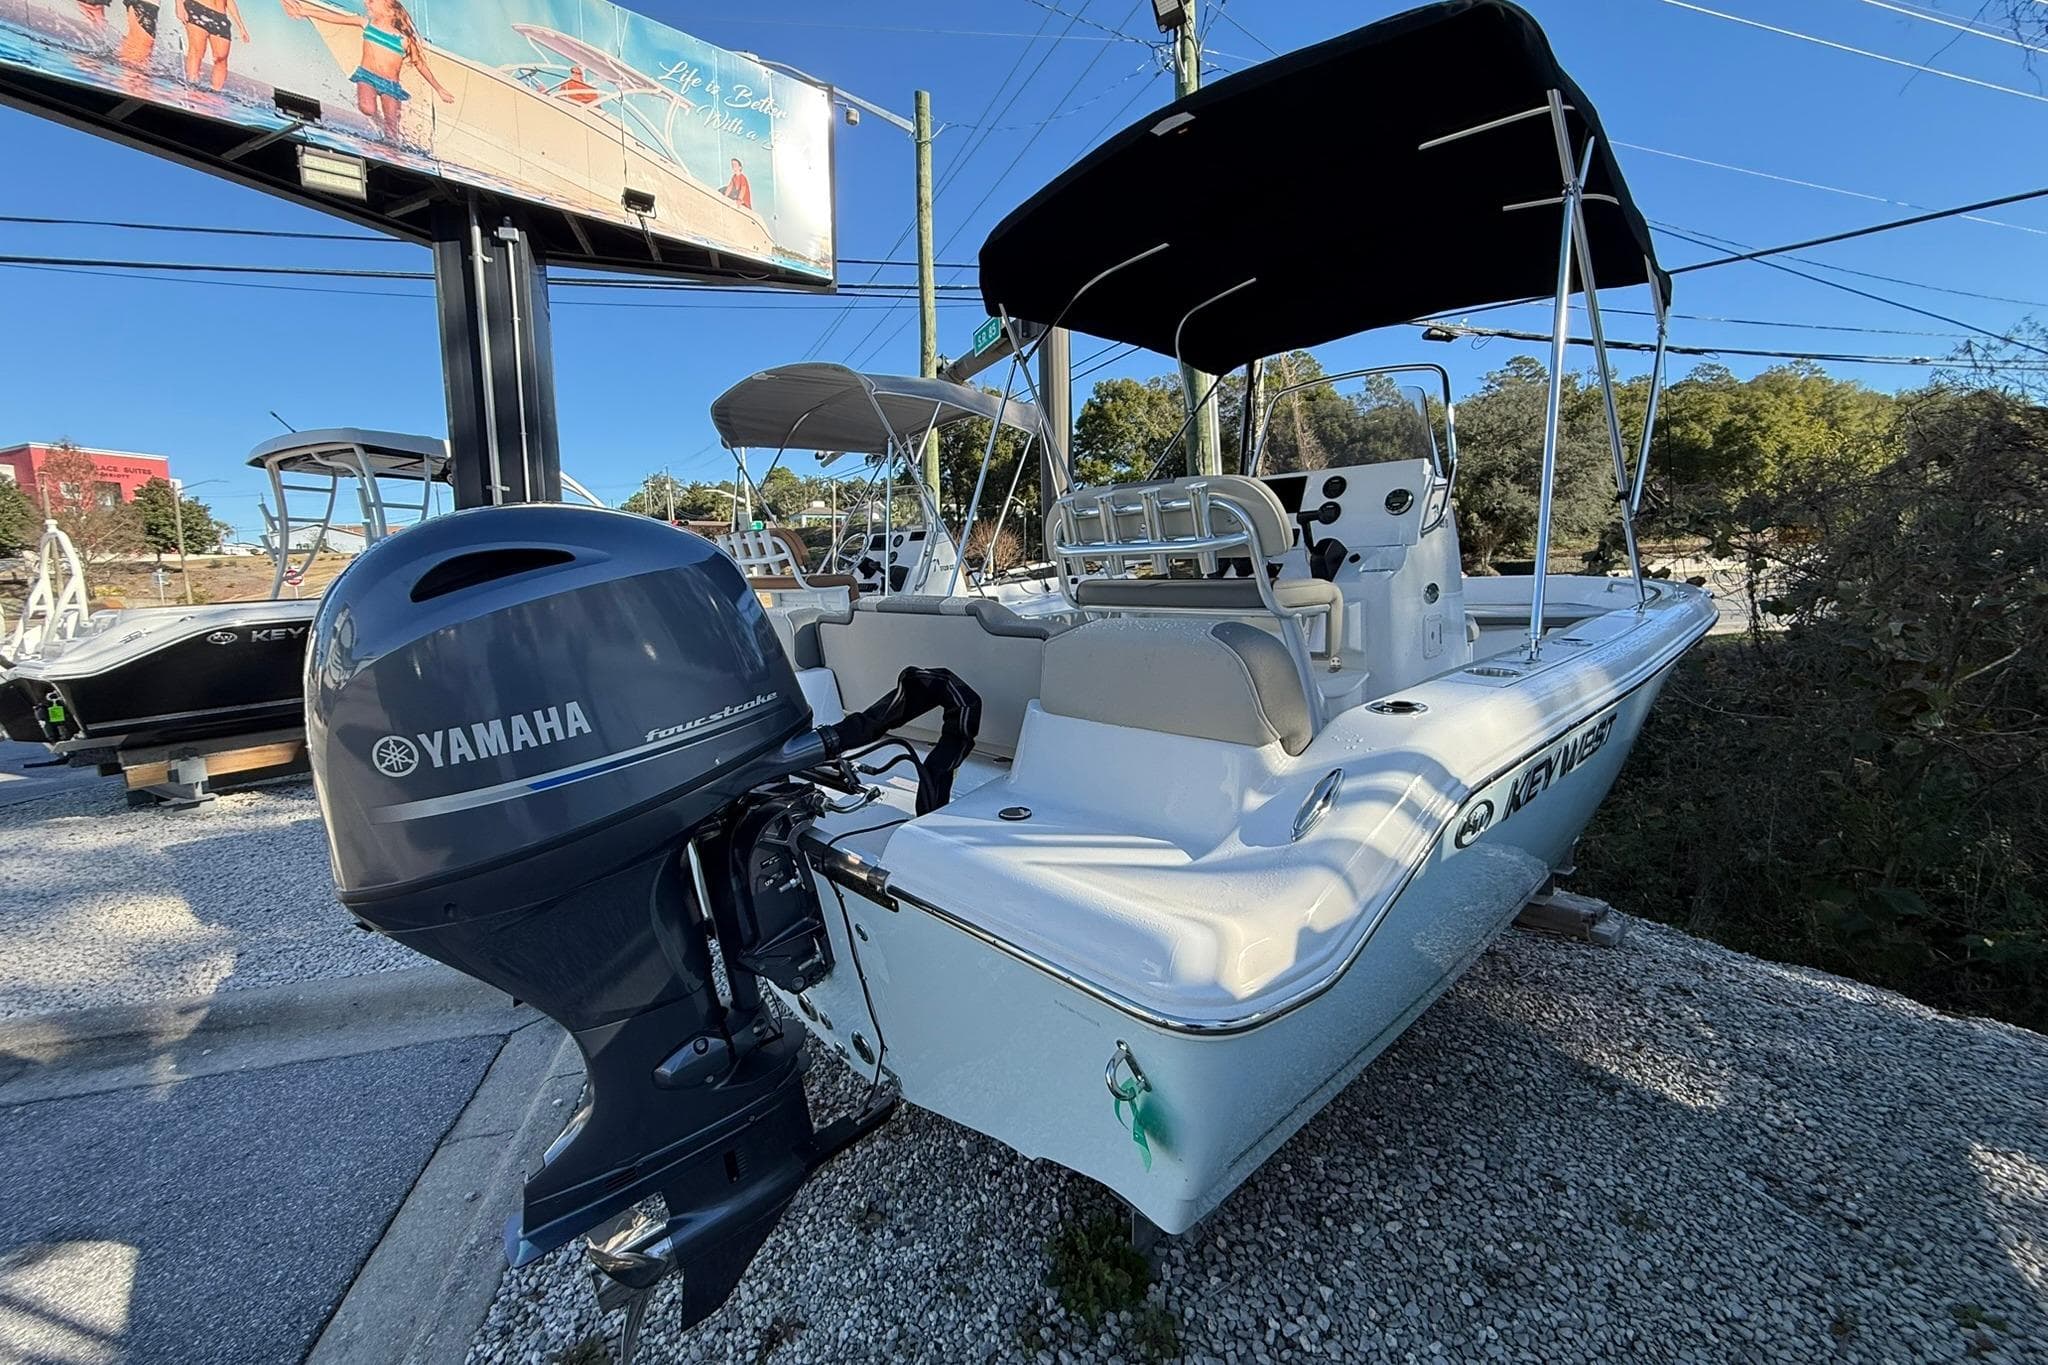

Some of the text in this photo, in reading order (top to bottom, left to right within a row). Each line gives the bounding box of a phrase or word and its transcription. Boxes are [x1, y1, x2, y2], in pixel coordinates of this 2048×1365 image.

[658, 61, 788, 119] Life is Better
[697, 104, 743, 136] With
[746, 130, 759, 141] a
[123, 467, 152, 475] SUITES
[251, 626, 305, 643] KEY
[416, 701, 593, 768] YAMAHA
